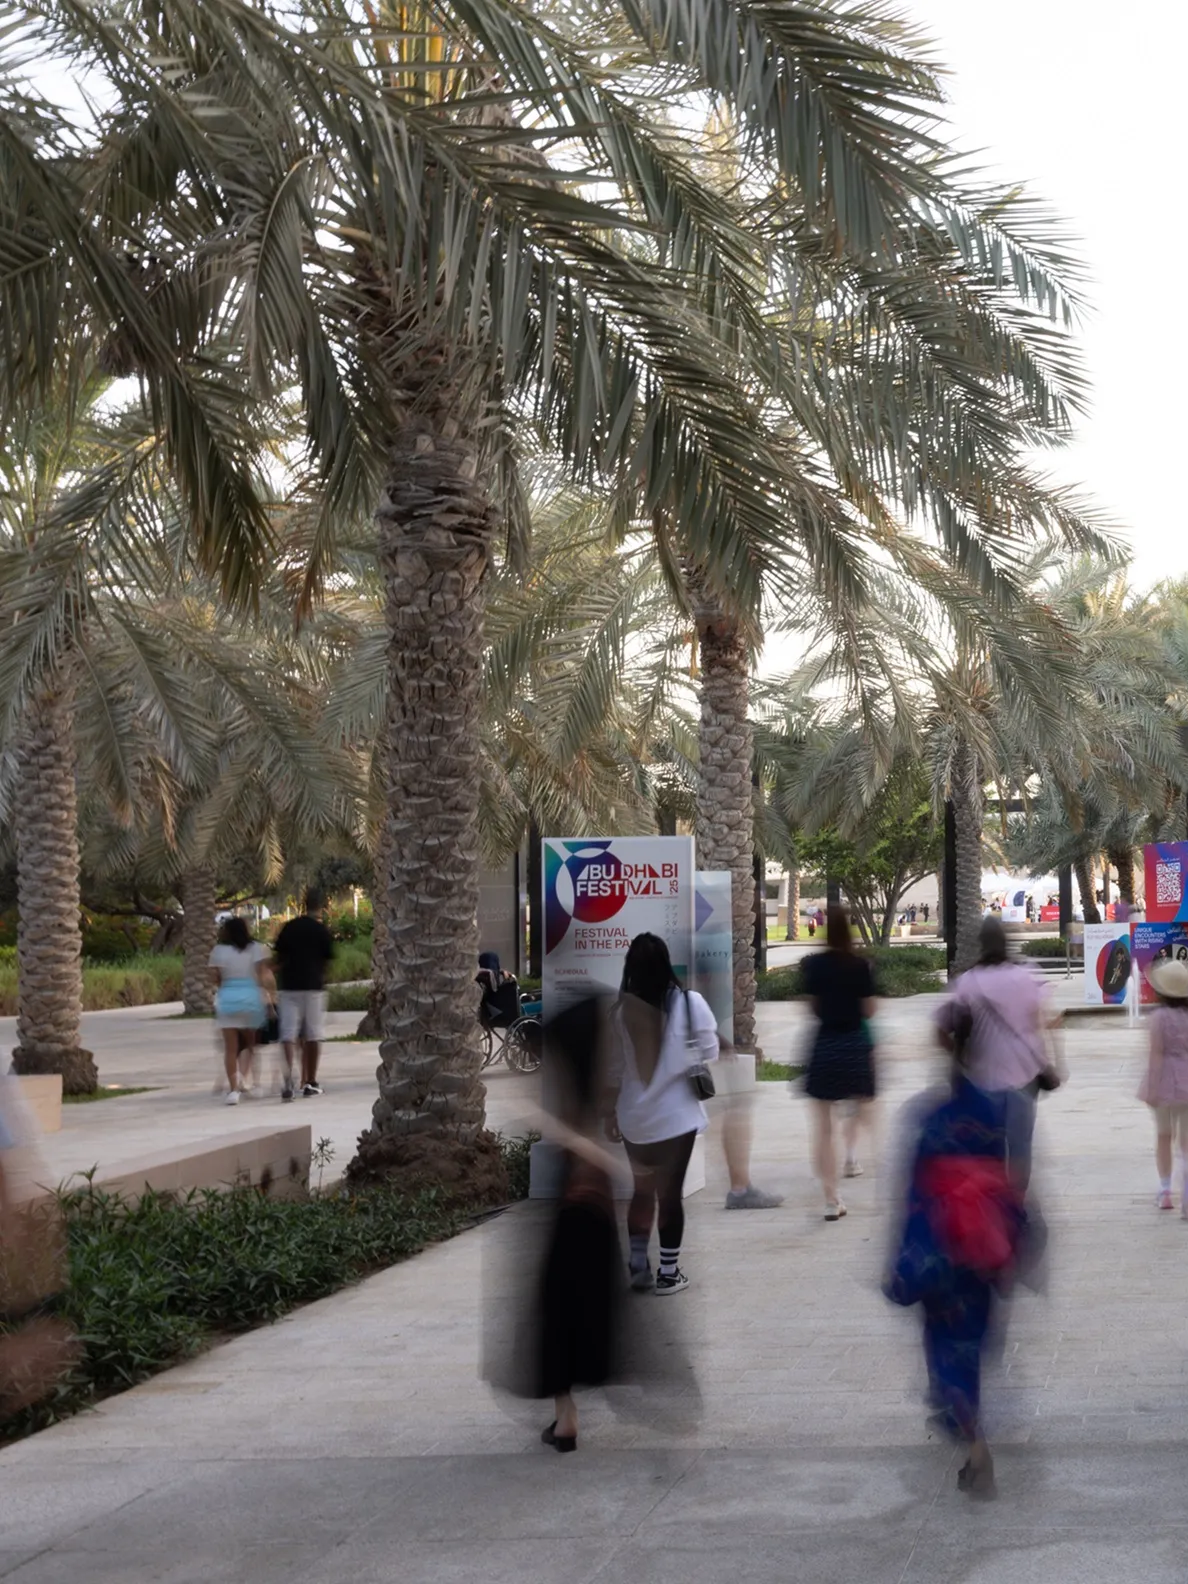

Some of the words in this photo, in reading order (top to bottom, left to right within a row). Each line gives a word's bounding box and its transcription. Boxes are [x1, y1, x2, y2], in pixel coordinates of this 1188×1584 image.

[577, 864, 615, 880] ABU
[621, 863, 678, 879] DHABI
[576, 880, 663, 897] FESTIVAL
[574, 928, 629, 938] FESTIVAL
[574, 940, 587, 950] IN
[590, 940, 612, 949] THE
[615, 939, 632, 949] PA
